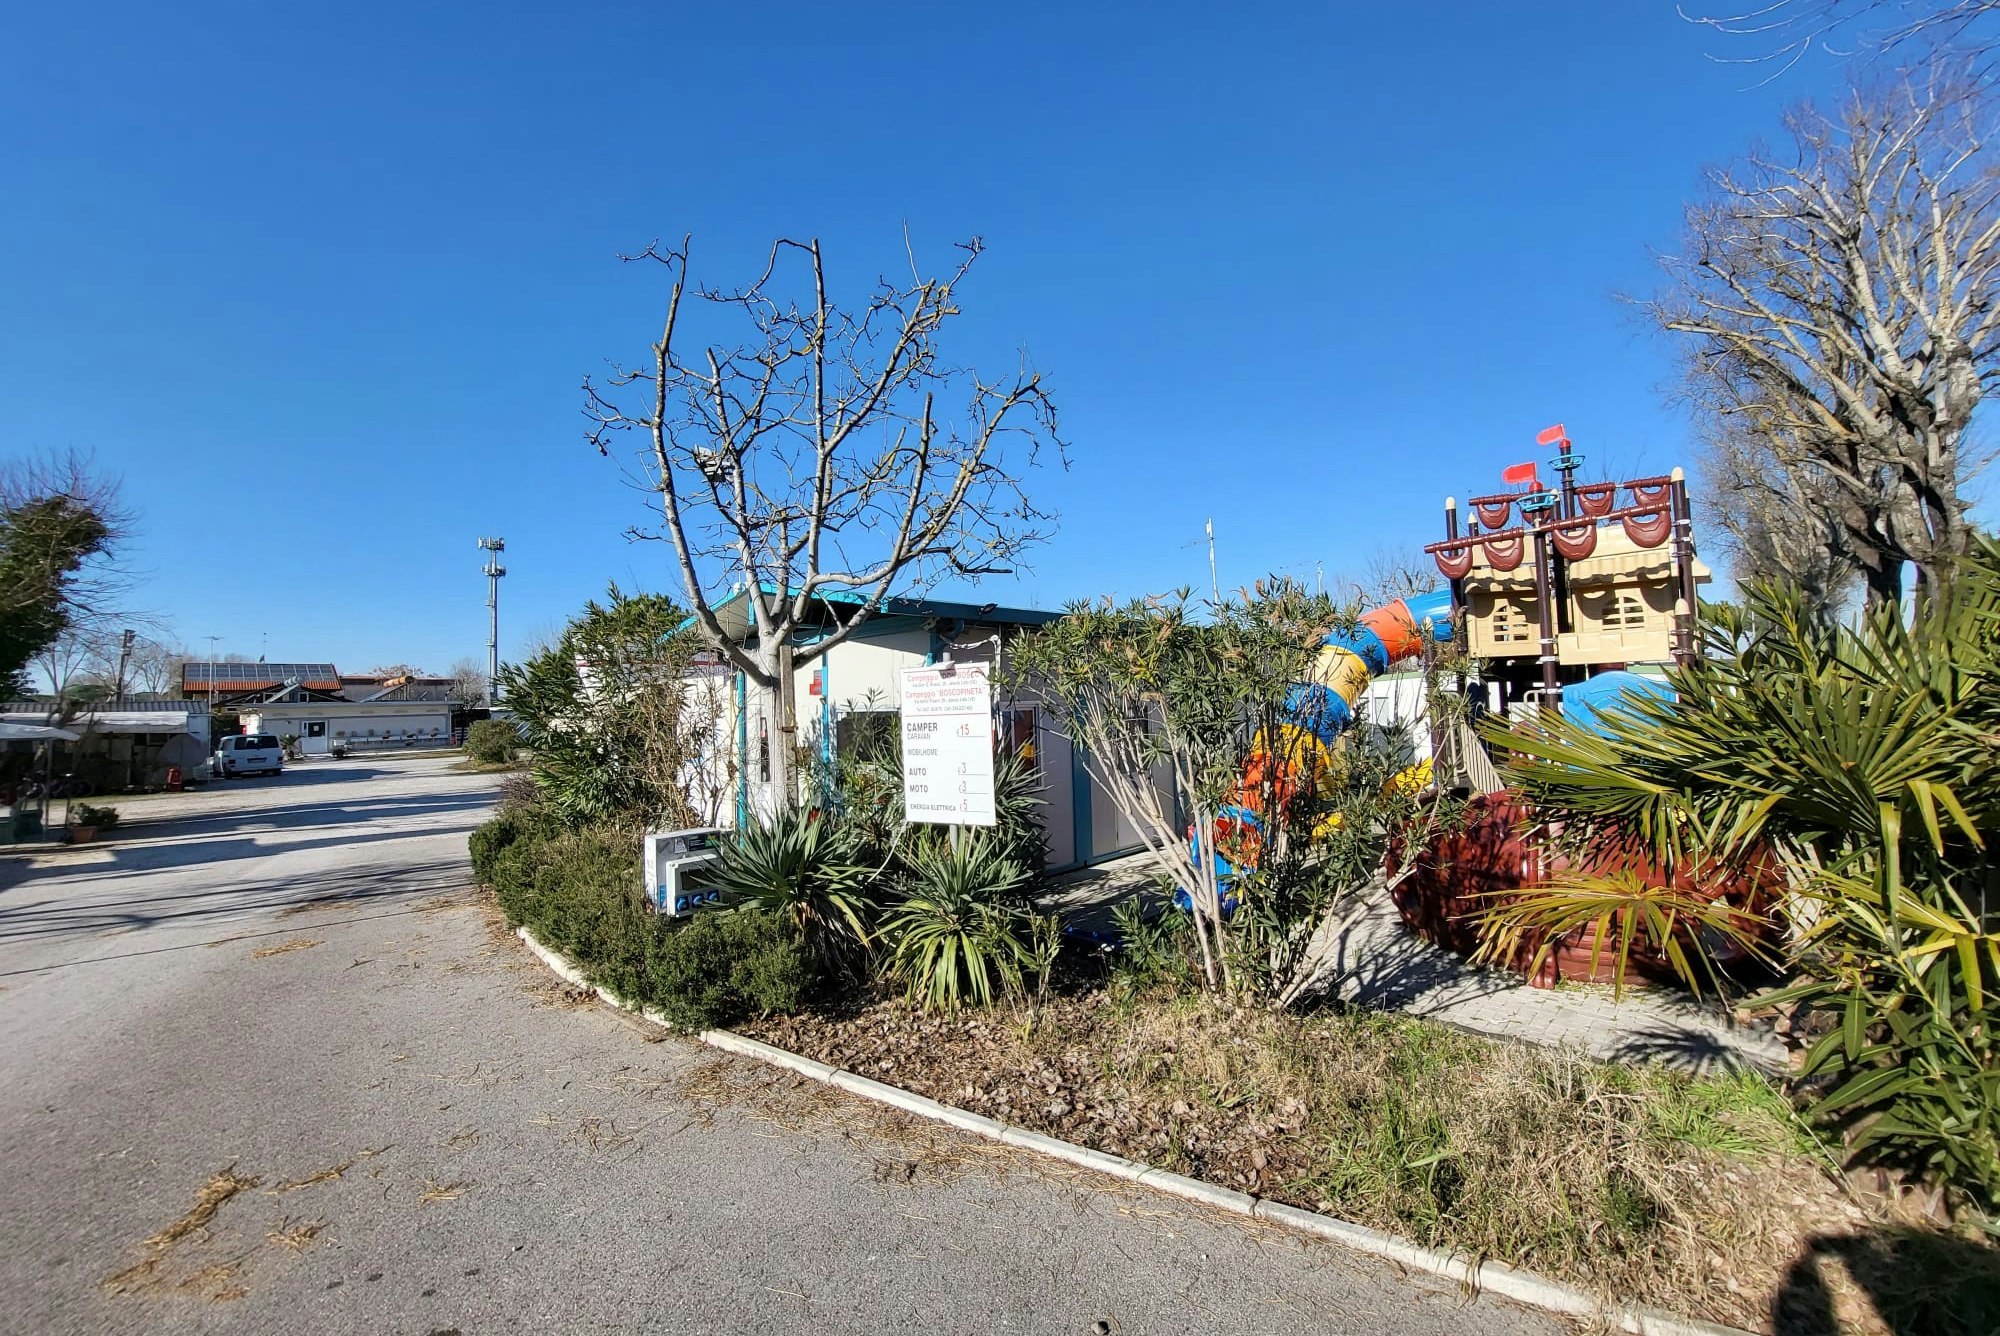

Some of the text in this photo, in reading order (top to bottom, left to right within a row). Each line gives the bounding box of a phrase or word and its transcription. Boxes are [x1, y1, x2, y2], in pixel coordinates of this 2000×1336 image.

[906, 722, 938, 732] CAMPER
[908, 767, 927, 776] AUTO
[909, 784, 929, 793] MOTO
